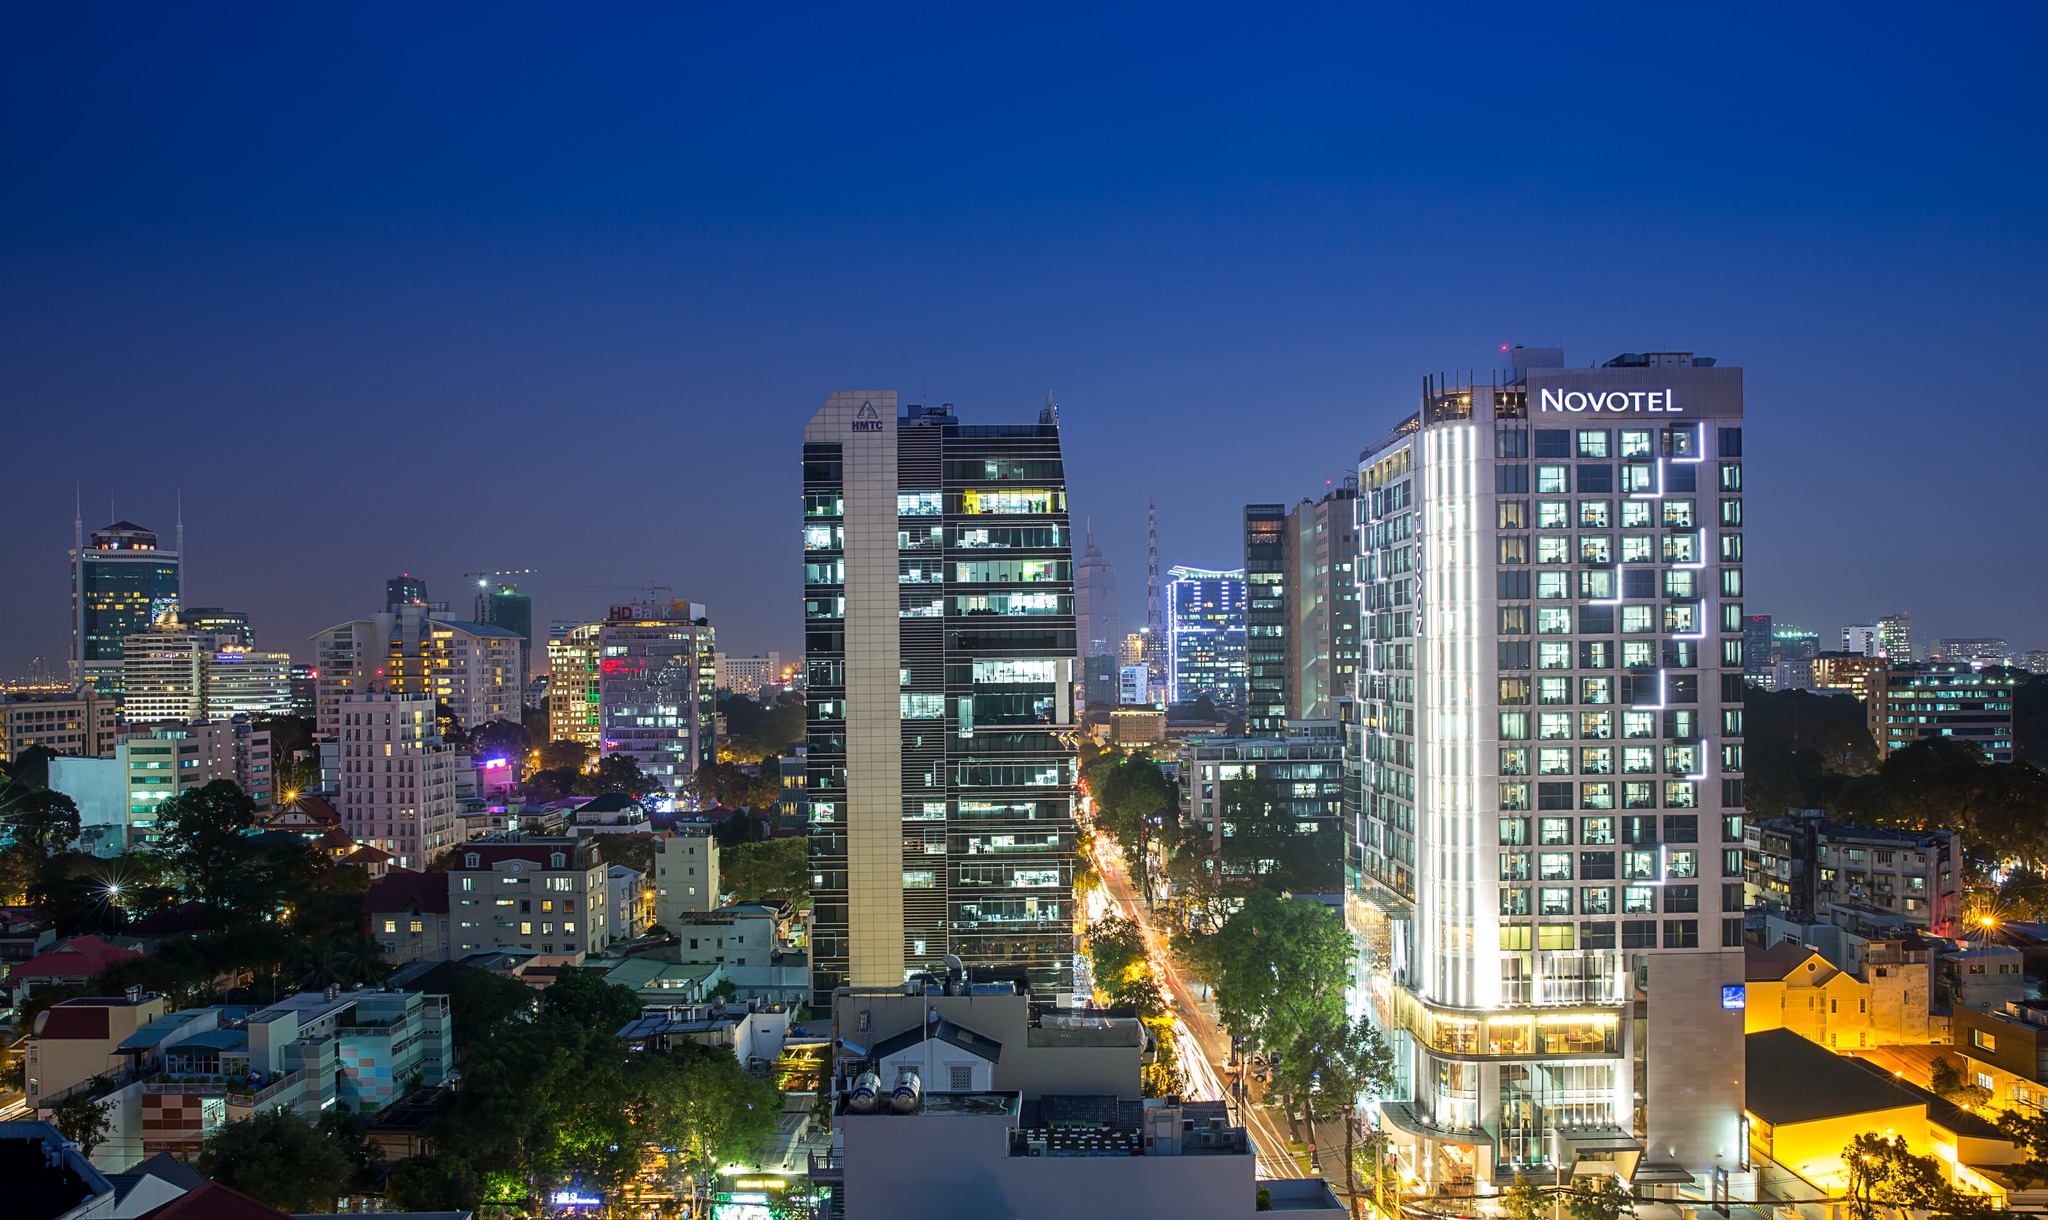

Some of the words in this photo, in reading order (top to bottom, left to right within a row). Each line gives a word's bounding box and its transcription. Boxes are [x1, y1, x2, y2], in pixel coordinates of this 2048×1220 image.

[1541, 388, 1683, 412] NOVOTEL
[852, 421, 883, 431] HMTC
[1415, 499, 1423, 637] NOVOTEL
